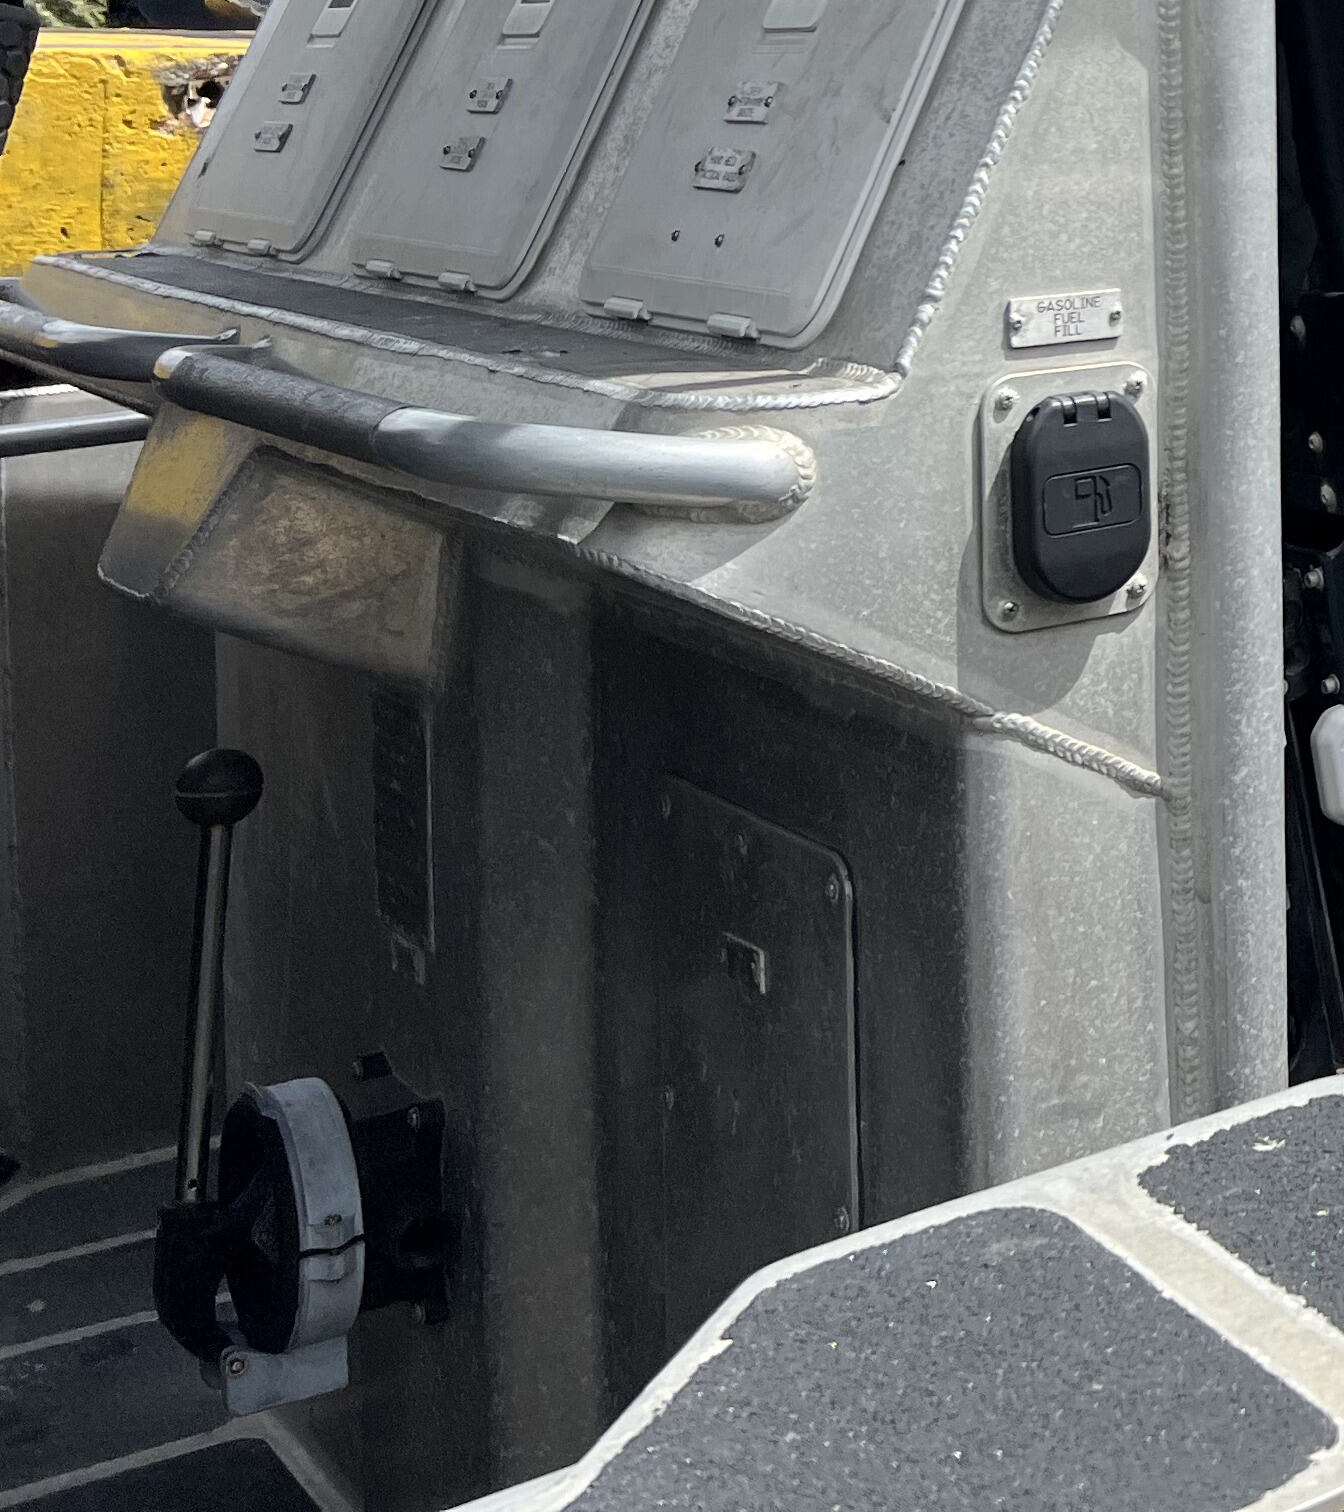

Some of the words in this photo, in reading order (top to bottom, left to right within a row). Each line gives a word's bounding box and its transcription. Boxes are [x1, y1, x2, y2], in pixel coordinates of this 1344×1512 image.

[1036, 295, 1102, 313] GASOLINE
[1053, 311, 1086, 325] FUEL
[1053, 324, 1083, 337] FILL
